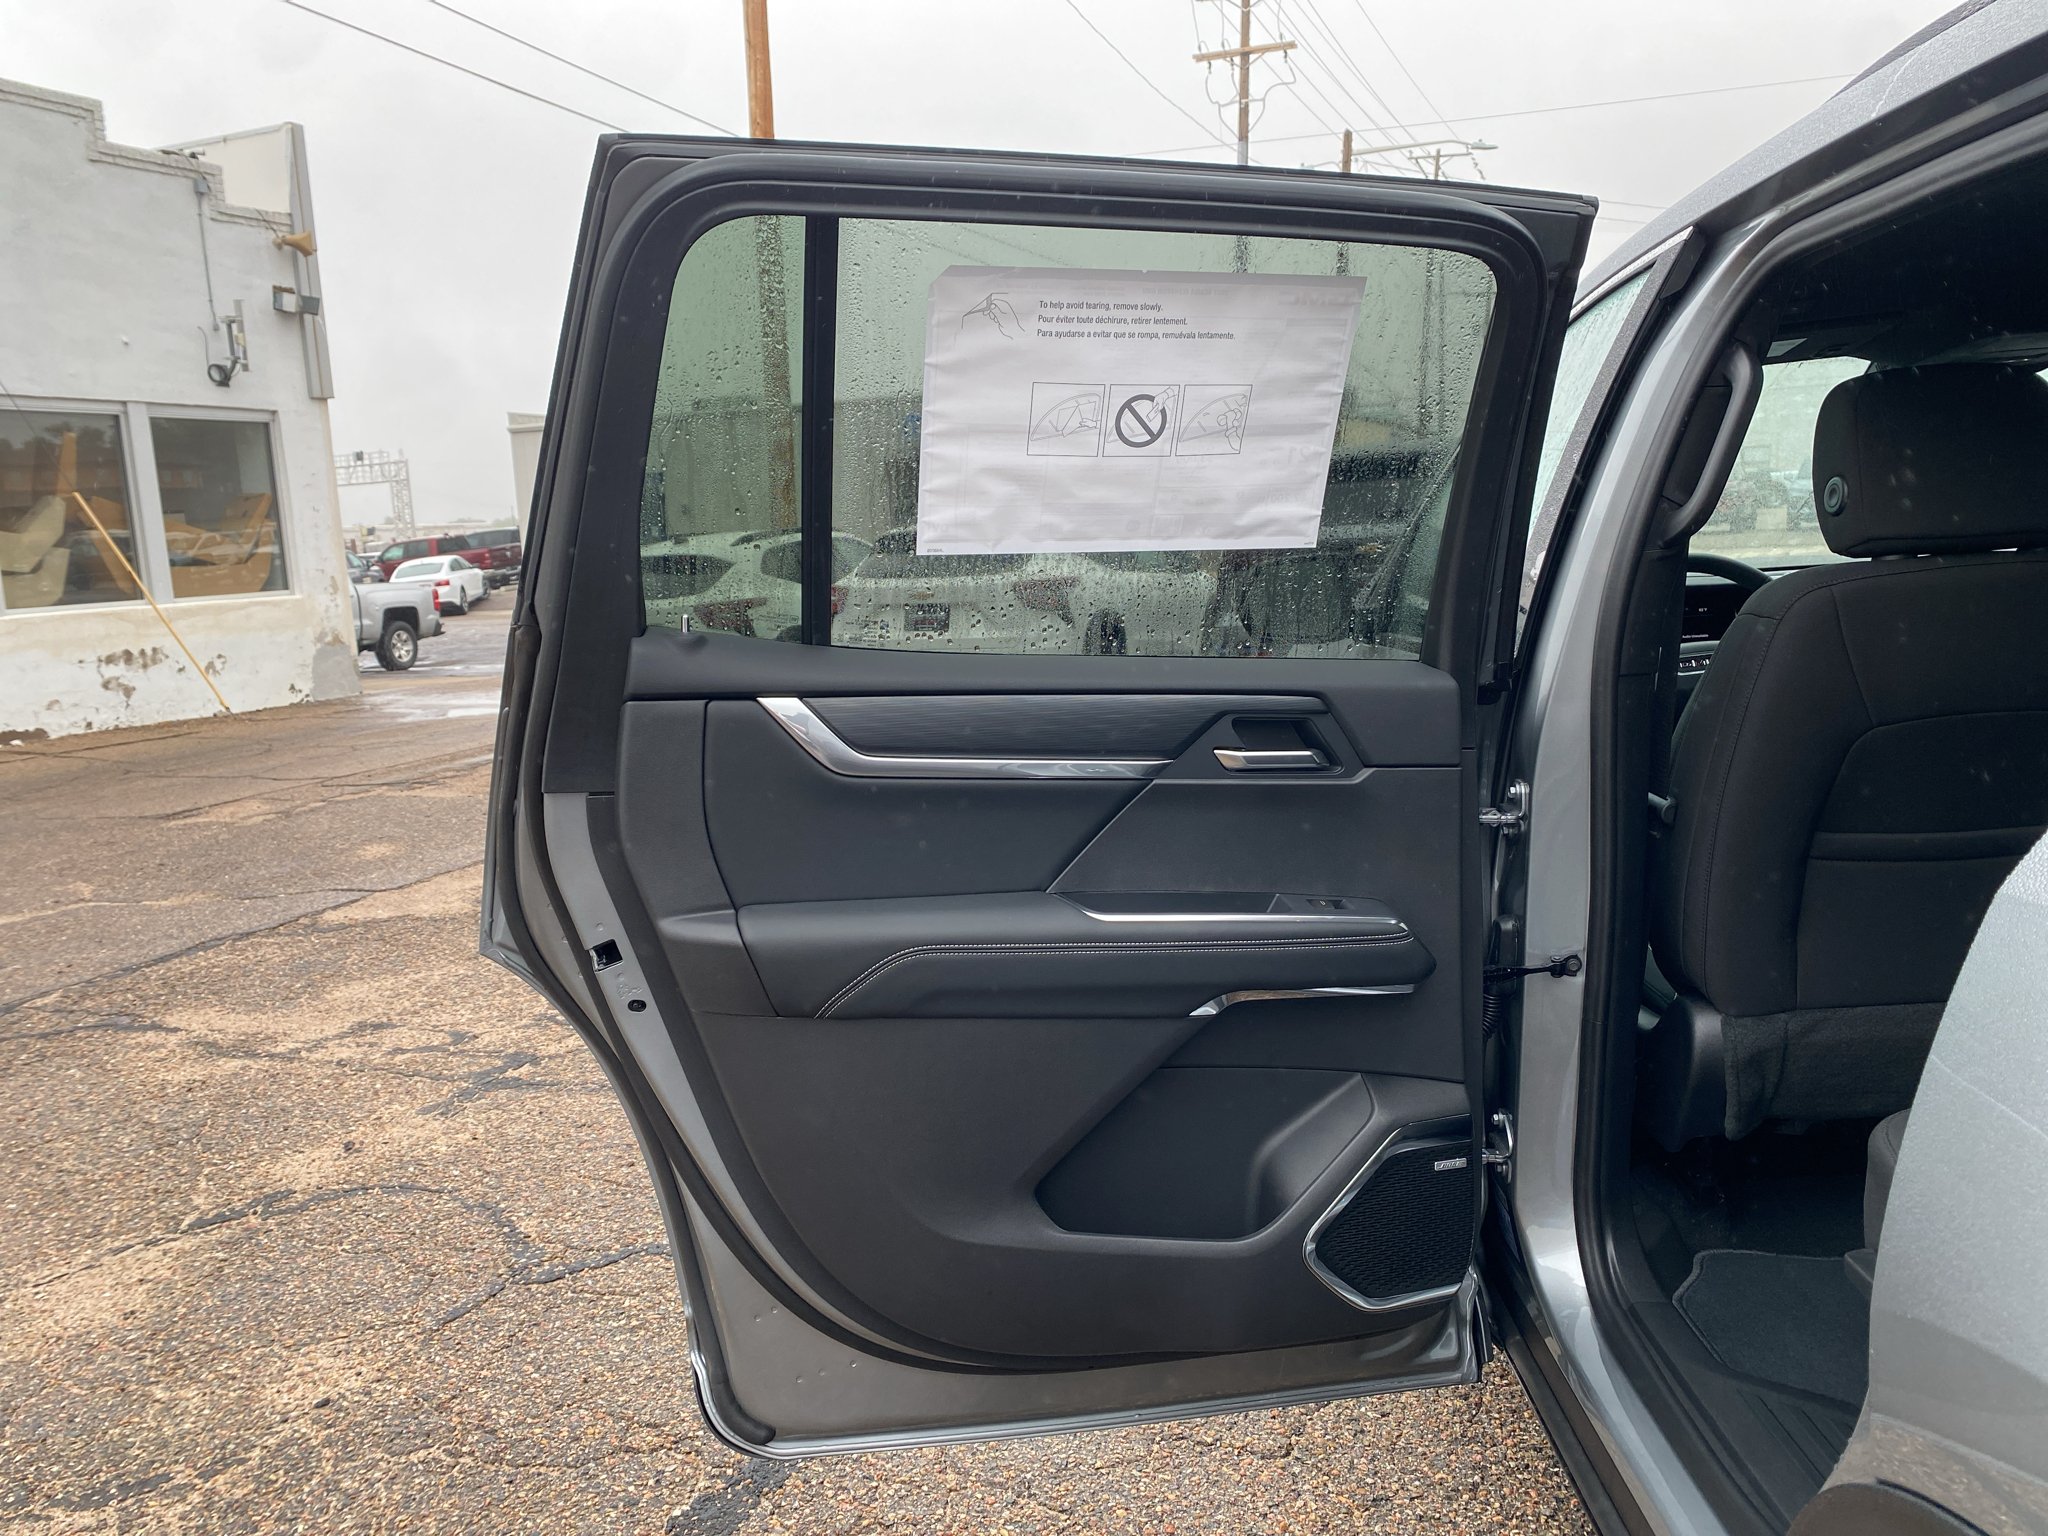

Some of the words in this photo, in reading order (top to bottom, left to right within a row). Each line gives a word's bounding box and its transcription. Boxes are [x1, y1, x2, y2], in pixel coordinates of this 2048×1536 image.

[1039, 301, 1048, 309] To
[1049, 301, 1065, 311] help
[1066, 301, 1084, 310] avoid
[1085, 302, 1112, 312] tearing,
[1140, 302, 1163, 312] slowly.
[1038, 315, 1054, 323] Pour
[1055, 315, 1075, 324] éviter
[1076, 316, 1094, 324] toute
[1095, 316, 1130, 325] déchirure,
[1131, 316, 1152, 325] retirer
[1153, 317, 1188, 325] lentement.
[1037, 329, 1053, 337] Para
[1054, 329, 1085, 339] ayudarse
[1093, 330, 1112, 338] evitar
[1113, 332, 1126, 340] que
[1137, 332, 1160, 340] rompa,
[1162, 331, 1196, 340] remuévala
[1197, 331, 1236, 340] lentamente.
